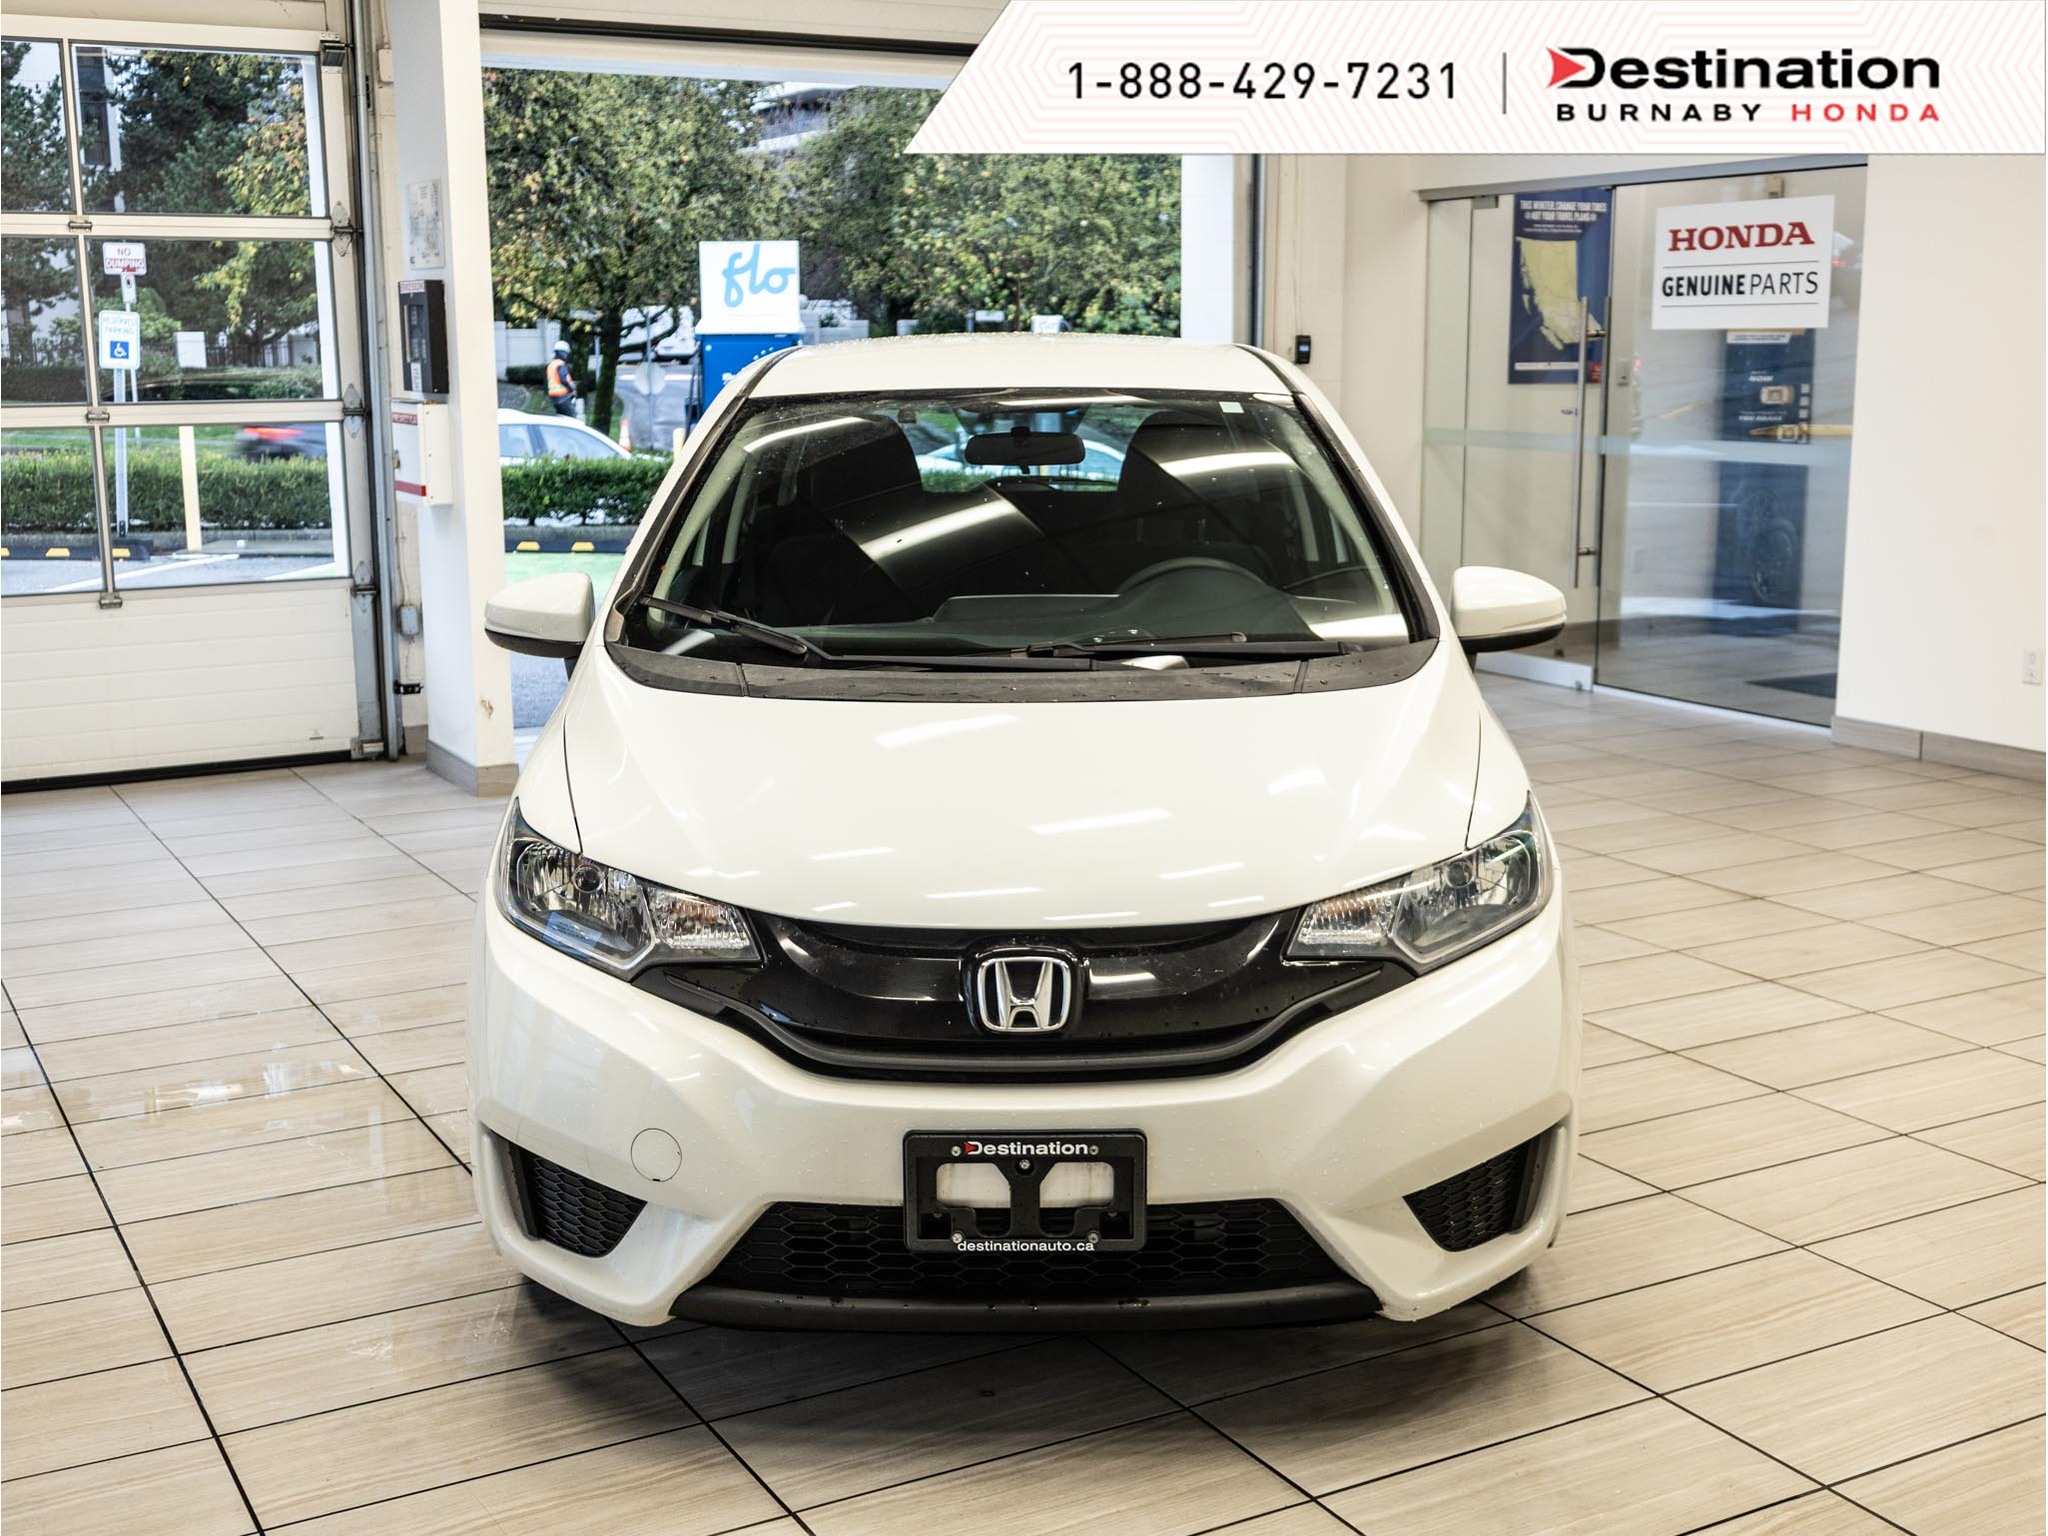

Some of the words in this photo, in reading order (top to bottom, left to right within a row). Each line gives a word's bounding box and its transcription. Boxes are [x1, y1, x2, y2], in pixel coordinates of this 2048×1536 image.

[1668, 221, 1815, 252] HONDA
[117, 247, 132, 257] NO
[721, 243, 796, 308] flo
[1662, 274, 1746, 297] GENUINE
[1750, 271, 1818, 296] PARTS
[964, 1141, 1089, 1156] Destination
[957, 1240, 1095, 1252] destinationauto.ca
